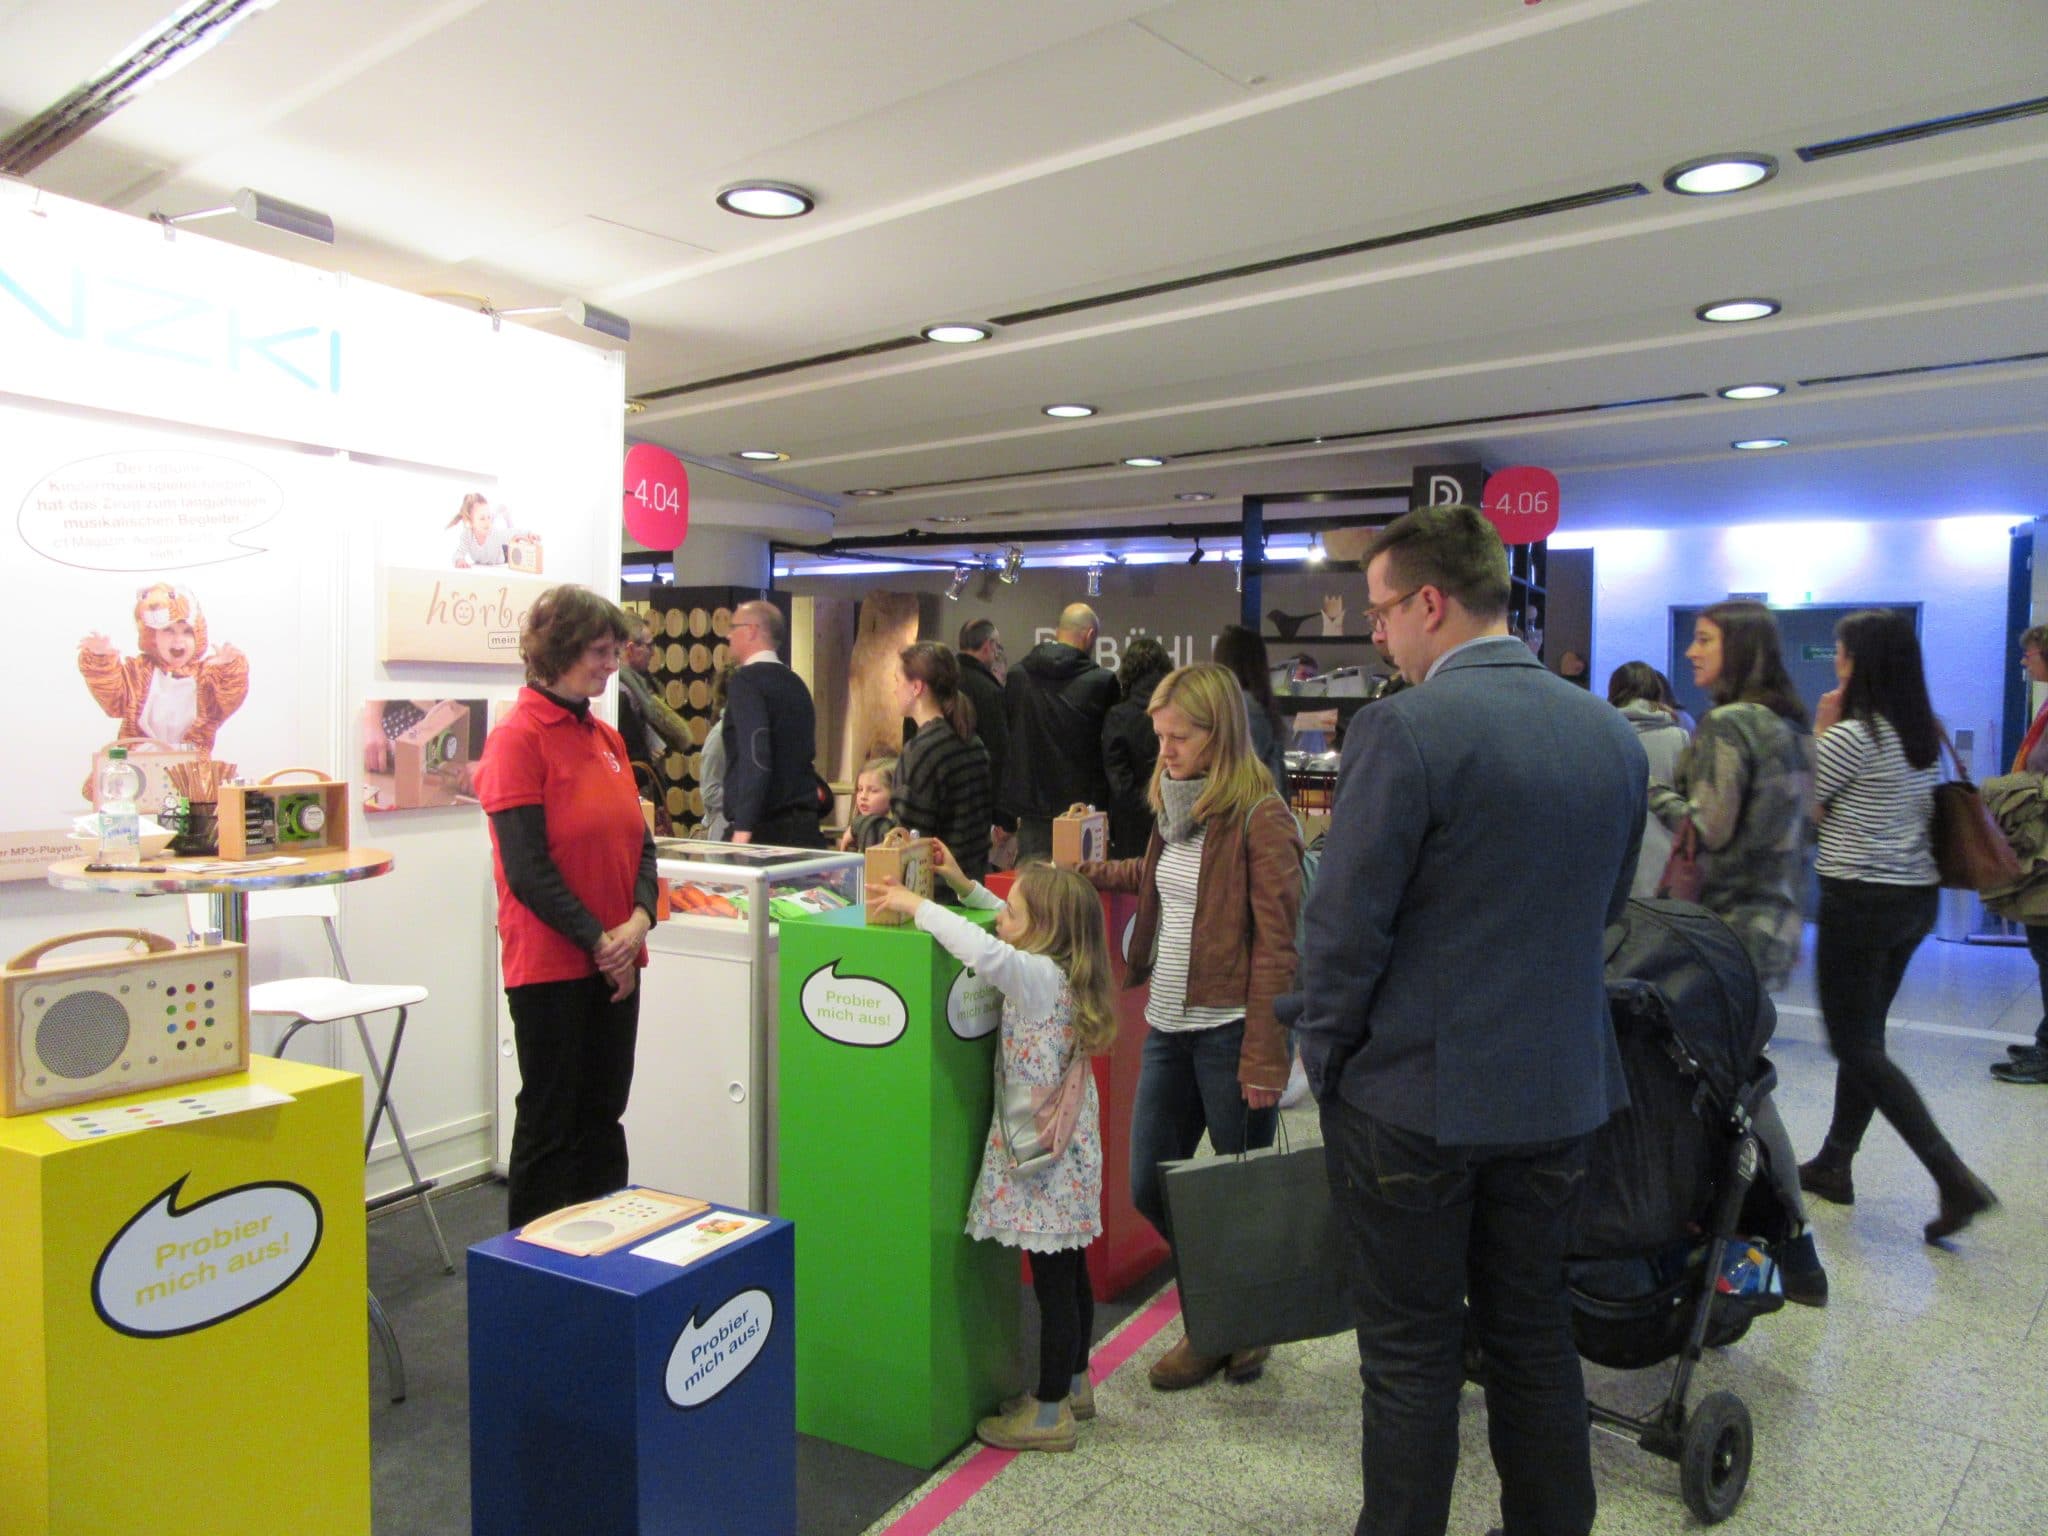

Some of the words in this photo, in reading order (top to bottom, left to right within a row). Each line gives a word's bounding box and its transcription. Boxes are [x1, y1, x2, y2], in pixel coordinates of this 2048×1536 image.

[634, 479, 680, 516] 4.04
[1495, 491, 1548, 515] 4.06
[491, 635, 517, 645] mein
[10, 845, 73, 857] MP3-Player
[825, 990, 881, 1009] Probier
[816, 1006, 854, 1023] mich
[858, 1013, 892, 1027] aus!
[155, 1215, 273, 1271] Probier
[135, 1260, 218, 1308] mich
[227, 1231, 291, 1275] aus!
[690, 1308, 750, 1365] Probier
[684, 1350, 724, 1391] mich
[728, 1317, 760, 1354] aus!
